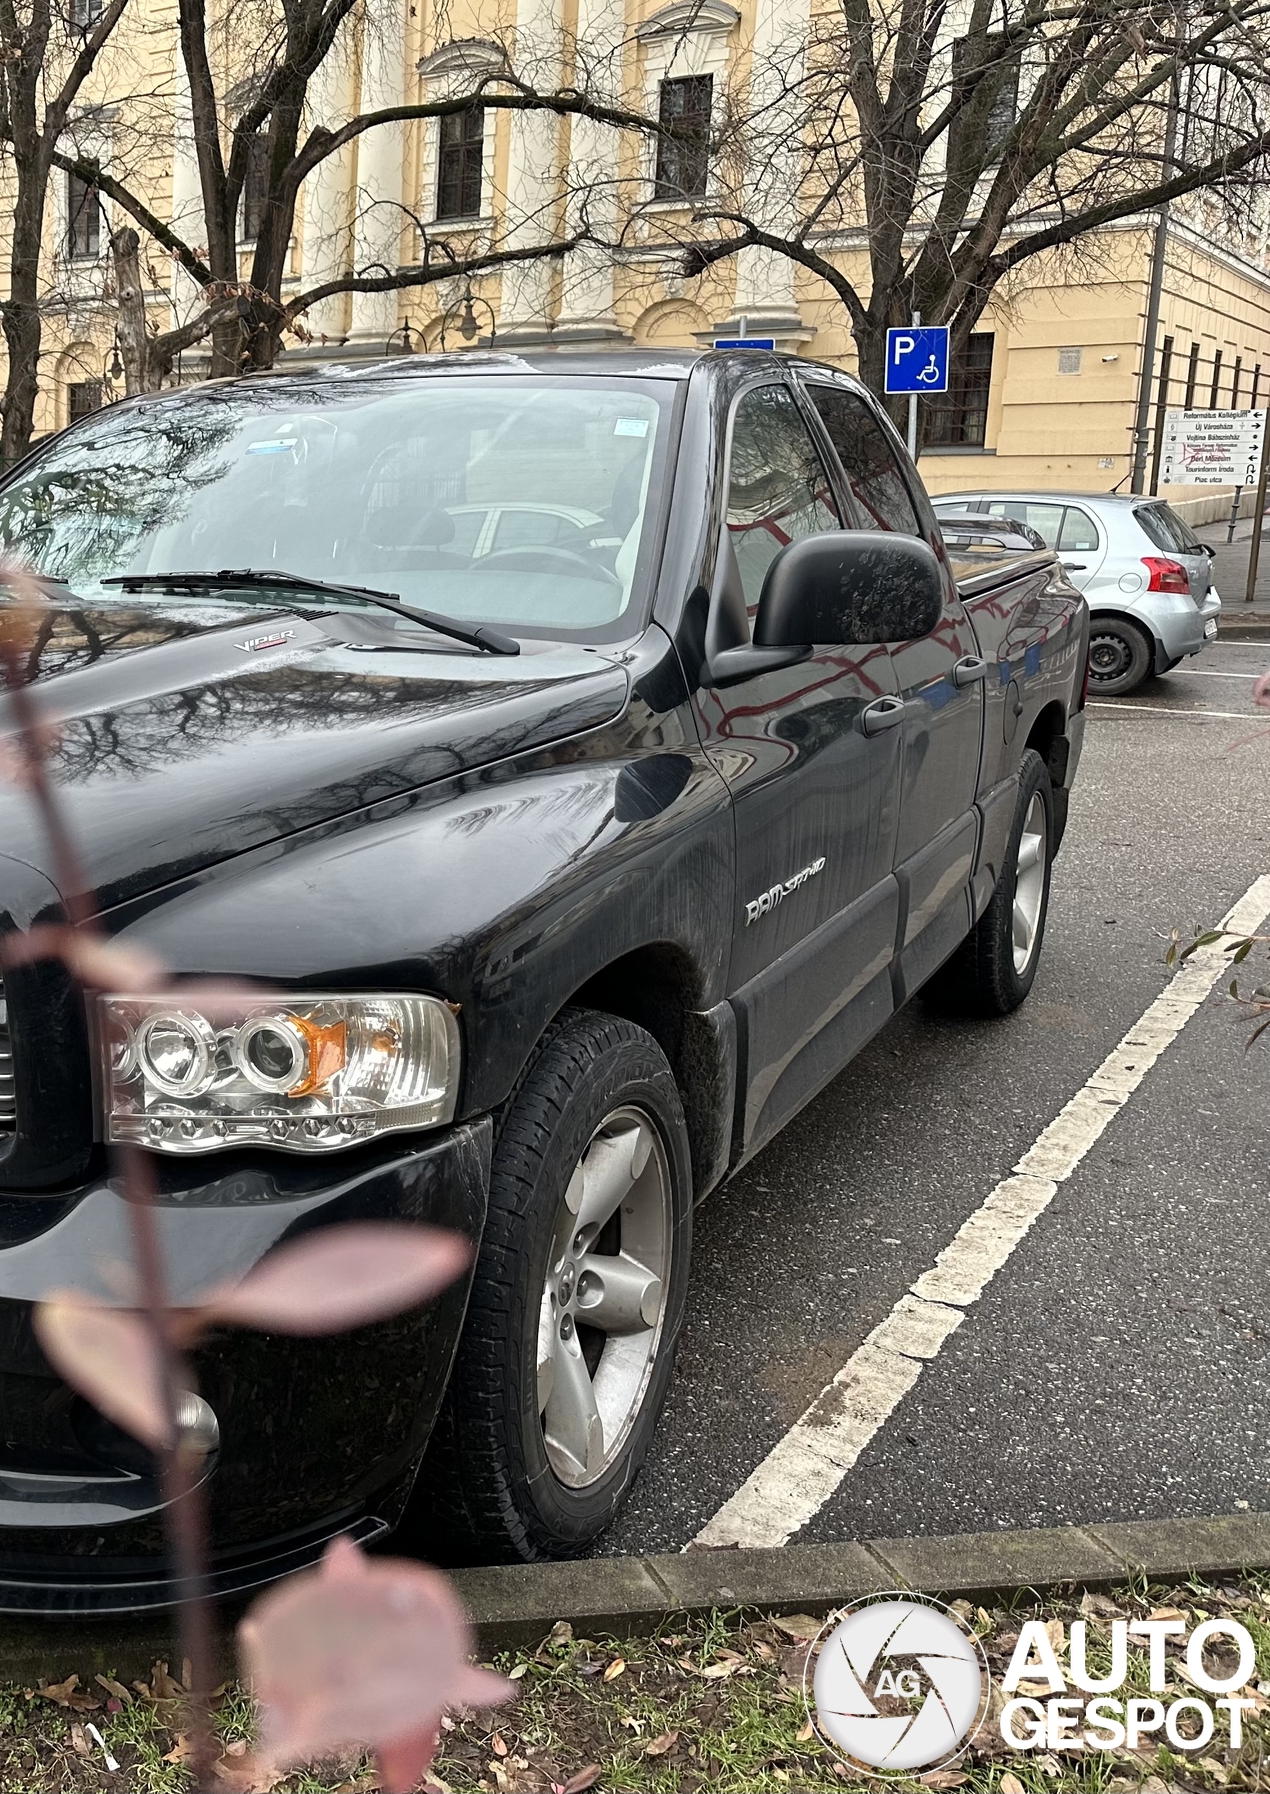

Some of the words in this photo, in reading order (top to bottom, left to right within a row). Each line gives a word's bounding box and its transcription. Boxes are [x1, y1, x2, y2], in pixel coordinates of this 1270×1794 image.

[894, 336, 915, 365] P
[1183, 411, 1216, 419] Református
[1218, 410, 1248, 419] Kollégium
[1195, 421, 1202, 431] Új
[1186, 434, 1206, 442] Vojtina
[1207, 433, 1240, 441] Bábszínház
[1186, 465, 1217, 473] Tourinform
[233, 630, 297, 652] VIPER
[745, 884, 783, 927] RAM
